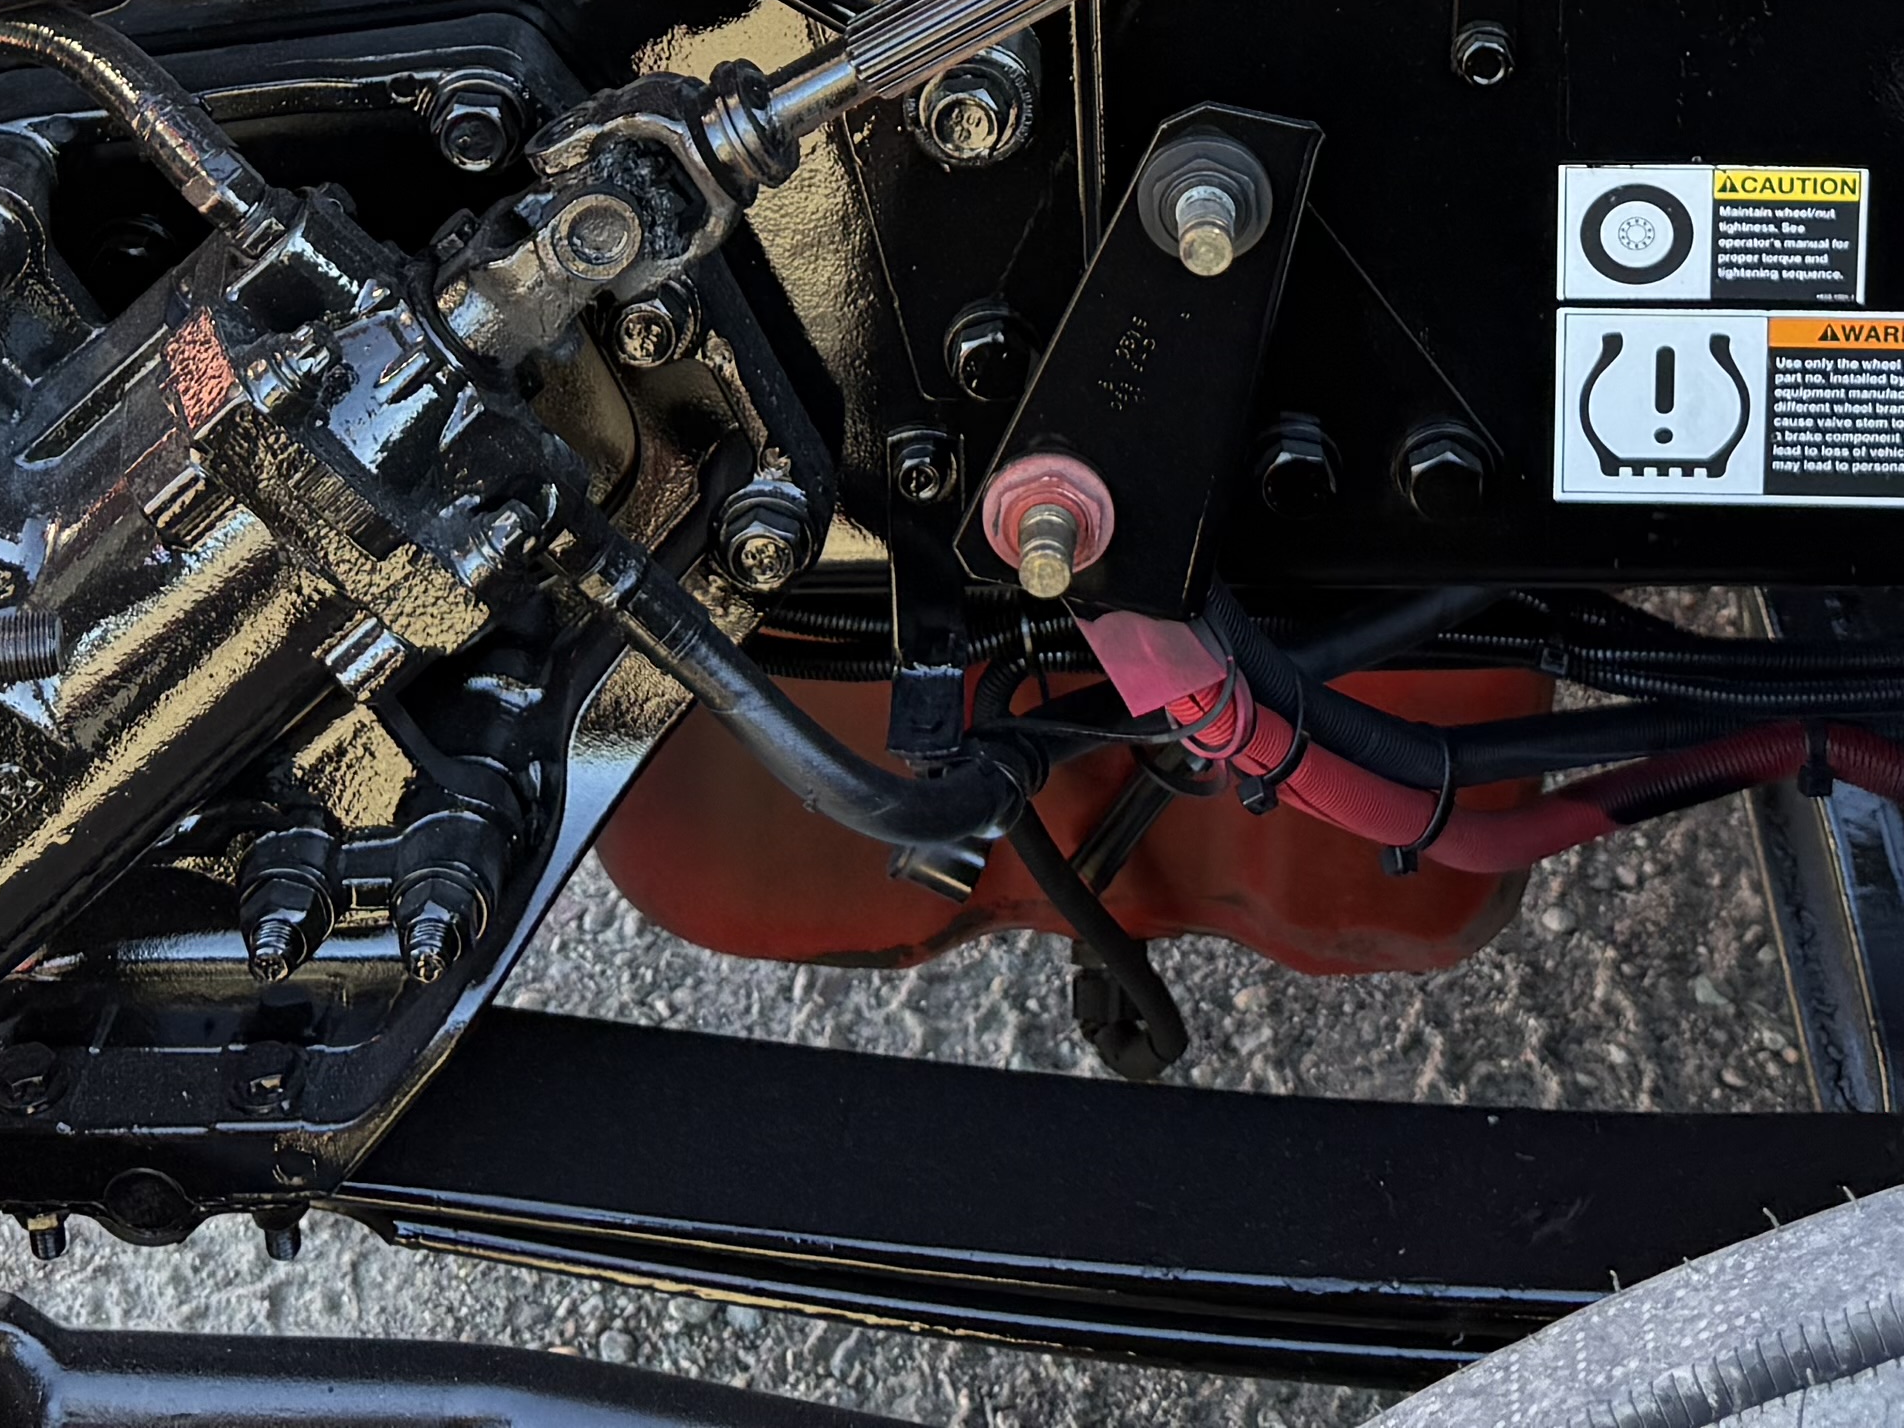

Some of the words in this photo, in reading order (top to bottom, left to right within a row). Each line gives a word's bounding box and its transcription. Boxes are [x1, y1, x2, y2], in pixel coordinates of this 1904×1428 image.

[1741, 175, 1857, 195] CAUTION
[1719, 206, 1773, 218] Maintain
[1718, 221, 1779, 235] tightness.
[1781, 221, 1806, 234] See
[1717, 237, 1782, 249] operator's
[1783, 238, 1830, 249] manual
[1832, 238, 1850, 250] for
[1717, 253, 1759, 265] proper
[1761, 252, 1803, 266] torque
[1804, 253, 1830, 265] and
[1717, 266, 1780, 281] tightening
[1781, 268, 1844, 281] sequence.
[1775, 357, 1803, 371] Use
[1804, 357, 1835, 373] only
[1836, 358, 1859, 371] the
[1861, 358, 1902, 371] wheel
[1775, 373, 1803, 386] part
[1804, 374, 1826, 385] no.
[1828, 372, 1887, 385] installed
[1773, 387, 1846, 401] equipment
[1773, 401, 1831, 414] different
[1833, 402, 1873, 415] wheel
[1773, 417, 1814, 429] cause
[1816, 416, 1853, 429] valve
[1855, 417, 1889, 430] stem
[1784, 430, 1823, 443] brake
[1825, 432, 1901, 446] component
[1772, 444, 1802, 457] lead
[1804, 445, 1819, 457] to
[1820, 445, 1850, 458] loss
[1852, 445, 1867, 458] of
[1771, 461, 1801, 474] may
[1803, 459, 1833, 472] lead
[1834, 461, 1849, 472] to
